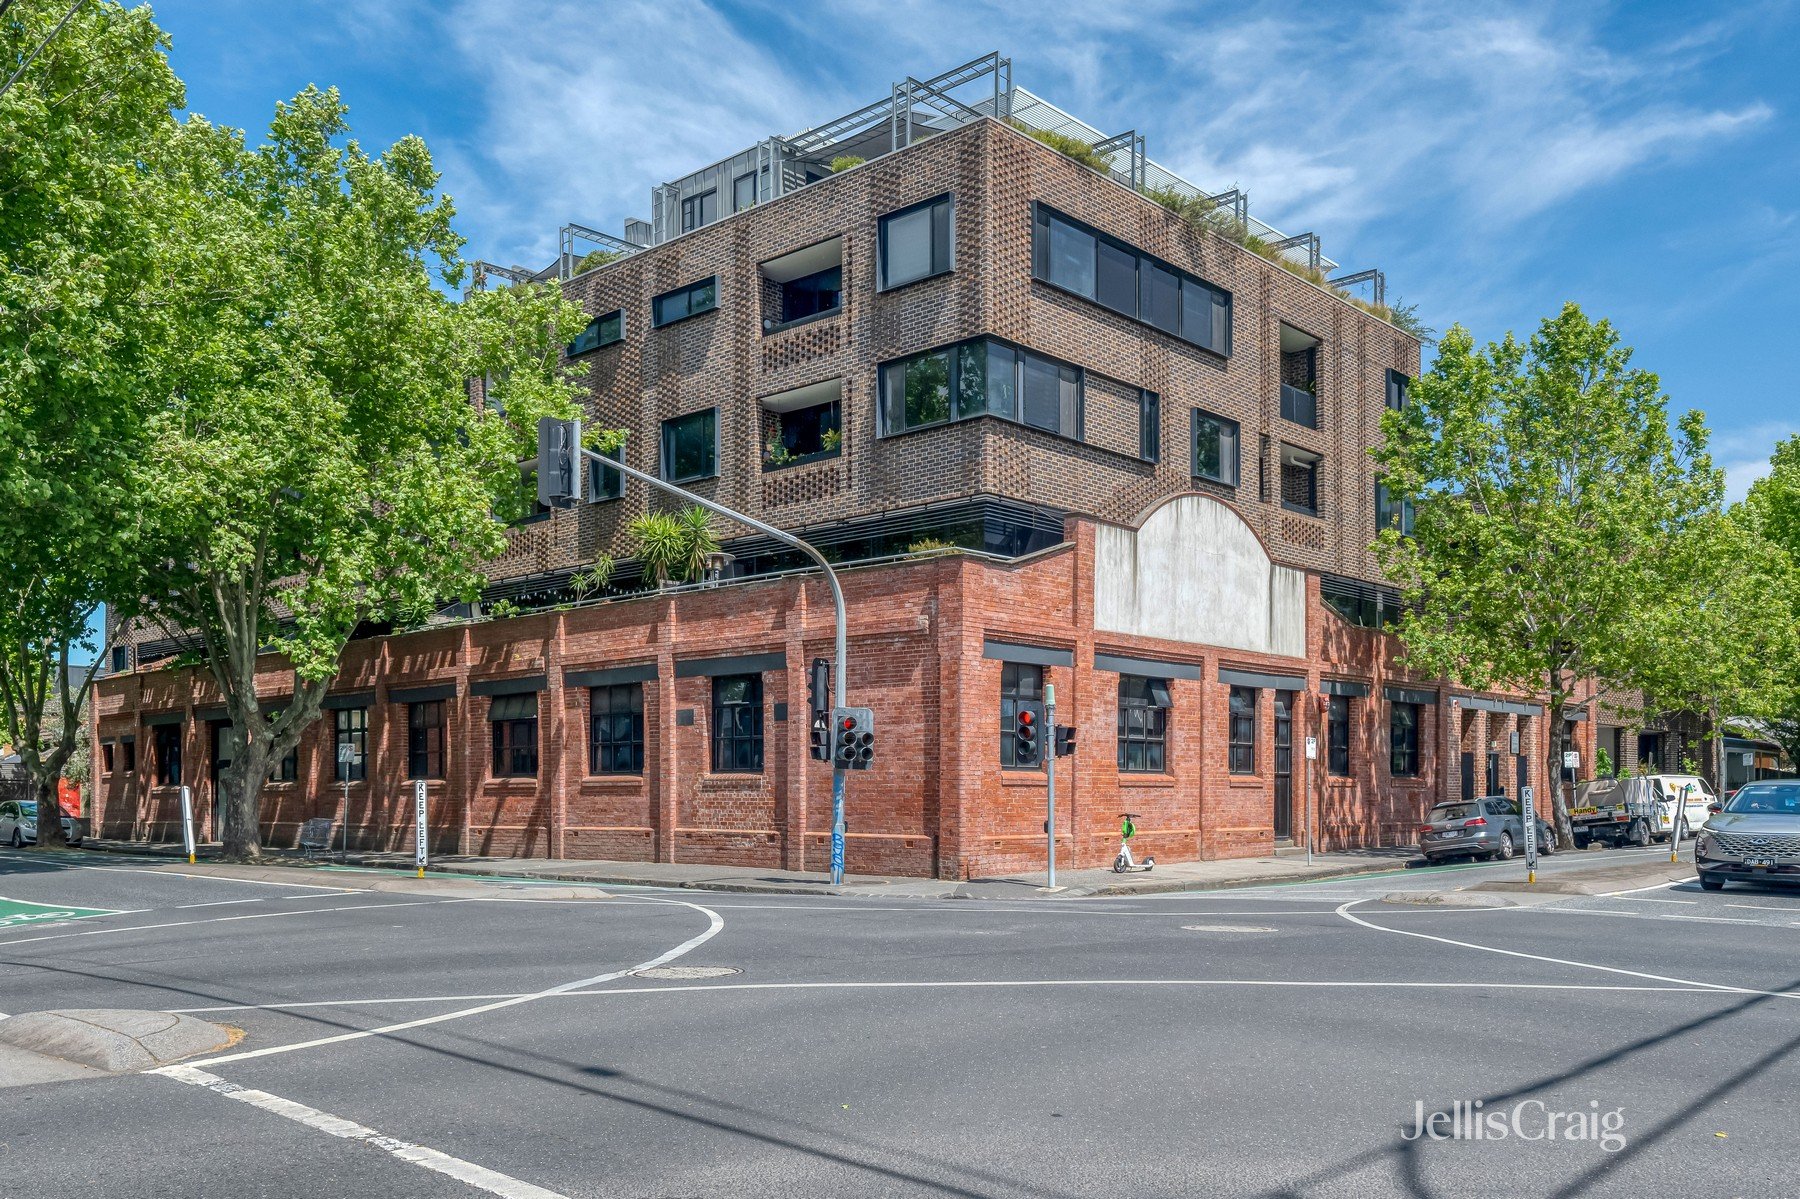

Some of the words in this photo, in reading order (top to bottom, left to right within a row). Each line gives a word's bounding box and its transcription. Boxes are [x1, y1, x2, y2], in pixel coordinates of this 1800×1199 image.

[1524, 789, 1532, 823] KEEP
[1573, 806, 1596, 815] Handy
[1526, 826, 1534, 859] LEFT
